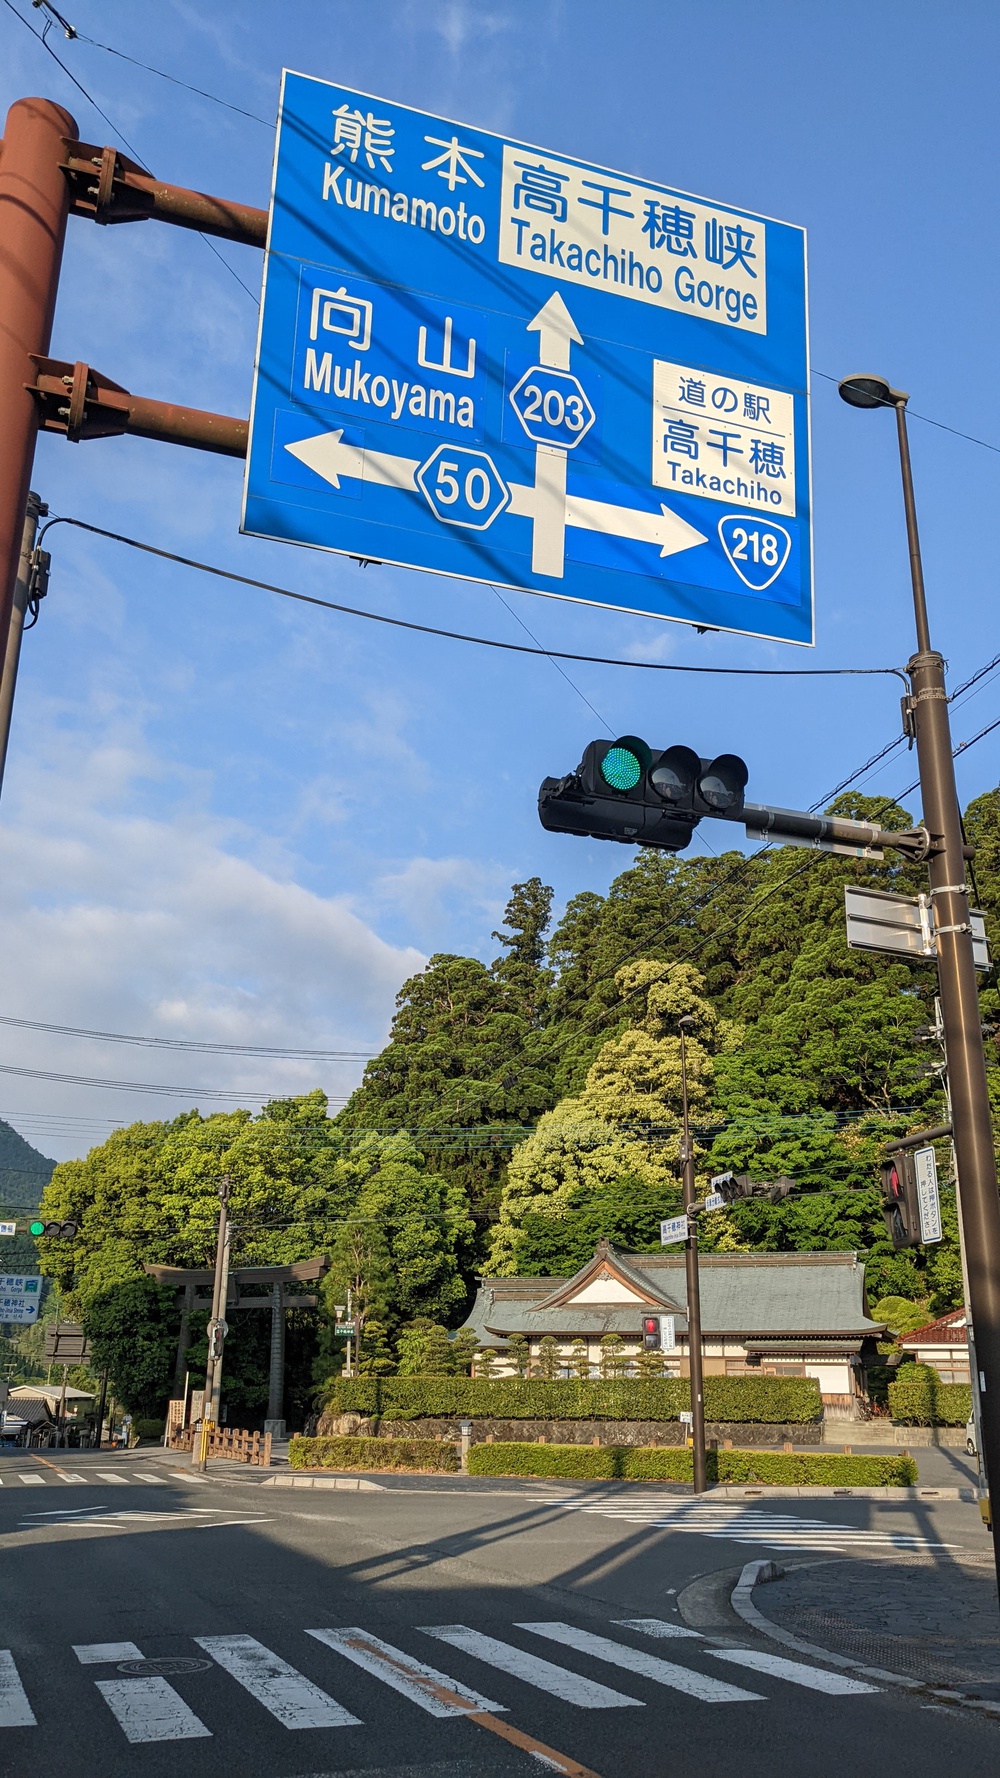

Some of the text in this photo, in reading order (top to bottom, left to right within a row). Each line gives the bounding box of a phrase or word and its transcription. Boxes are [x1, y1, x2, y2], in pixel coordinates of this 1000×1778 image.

[331, 104, 485, 191] 熊本
[322, 163, 485, 244] Kumamoto
[513, 164, 757, 279] 高千穂峡
[511, 218, 758, 322] Takachiho Gorge
[309, 287, 476, 379] 向山
[304, 349, 474, 429] Mukoyama
[523, 385, 584, 427] 203
[678, 376, 771, 424] 道の駅
[436, 463, 491, 505] 50
[662, 419, 786, 480] 高千穂
[667, 461, 782, 506] Takachiho
[733, 528, 778, 567] 218
